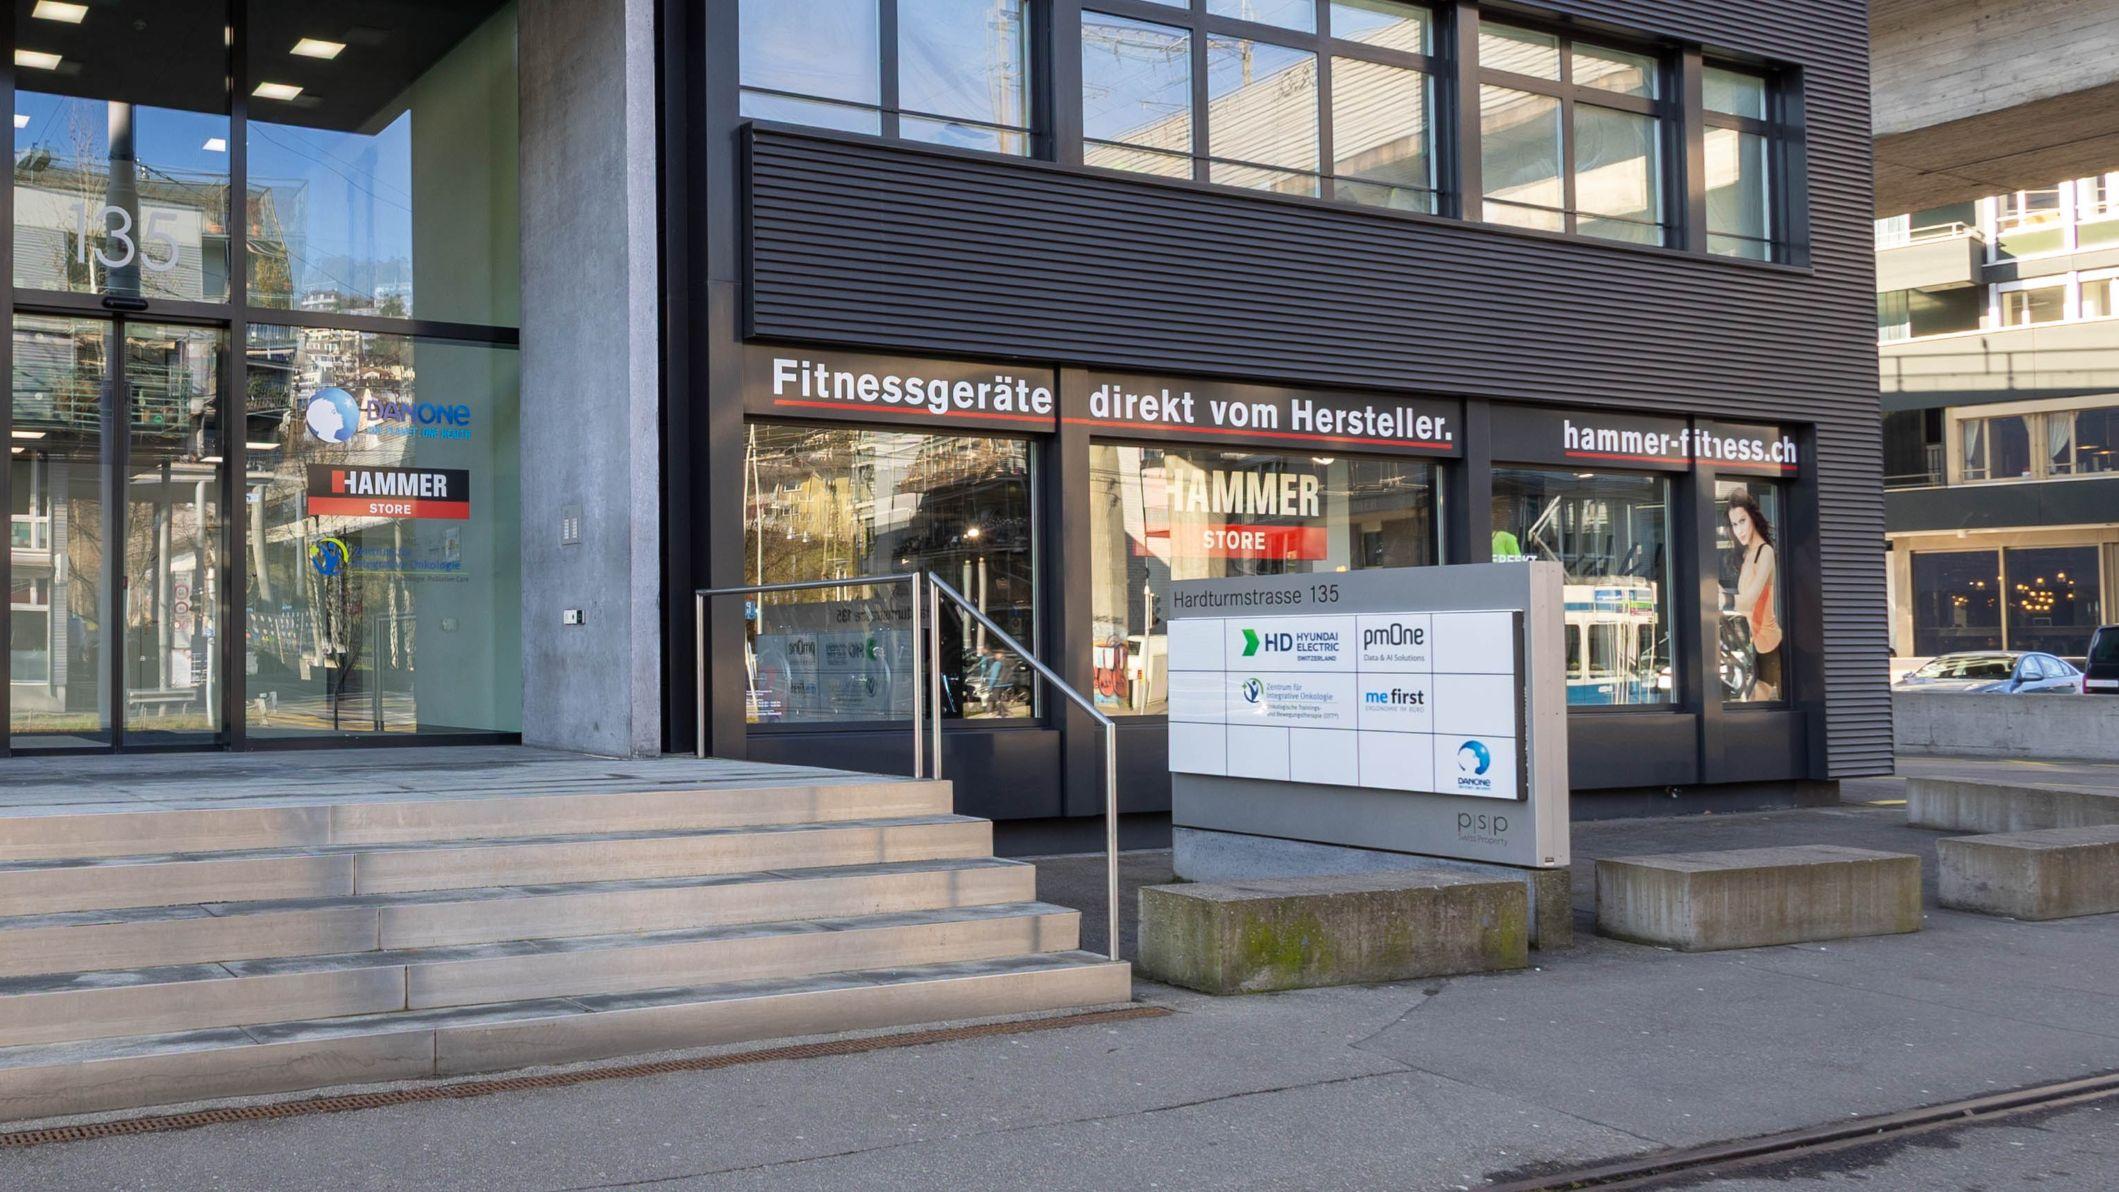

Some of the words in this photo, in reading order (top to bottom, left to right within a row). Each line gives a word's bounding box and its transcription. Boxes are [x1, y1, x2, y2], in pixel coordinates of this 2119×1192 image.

[72, 204, 179, 271] 135
[773, 358, 1053, 414] Fitnessgeräte
[1089, 384, 1195, 423] direkt
[1210, 400, 1278, 429] vom
[1291, 399, 1452, 440] Hersteller.
[1564, 419, 1797, 463] hammer-fitness.ch
[332, 470, 447, 497] HAMMER
[1166, 468, 1320, 517] HAMMER
[369, 503, 412, 514] STORE
[1203, 530, 1266, 550] STORE
[1174, 589, 1301, 608] Hardturmstrasse
[1310, 584, 1339, 603] 135
[1265, 633, 1293, 652] HD
[1296, 632, 1338, 641] HYUNDAI
[1296, 643, 1340, 652] ELECTRIC
[1364, 623, 1424, 650] pmOne
[1366, 692, 1388, 703] me
[1391, 688, 1424, 704] first
[1458, 778, 1491, 786] DANONE
